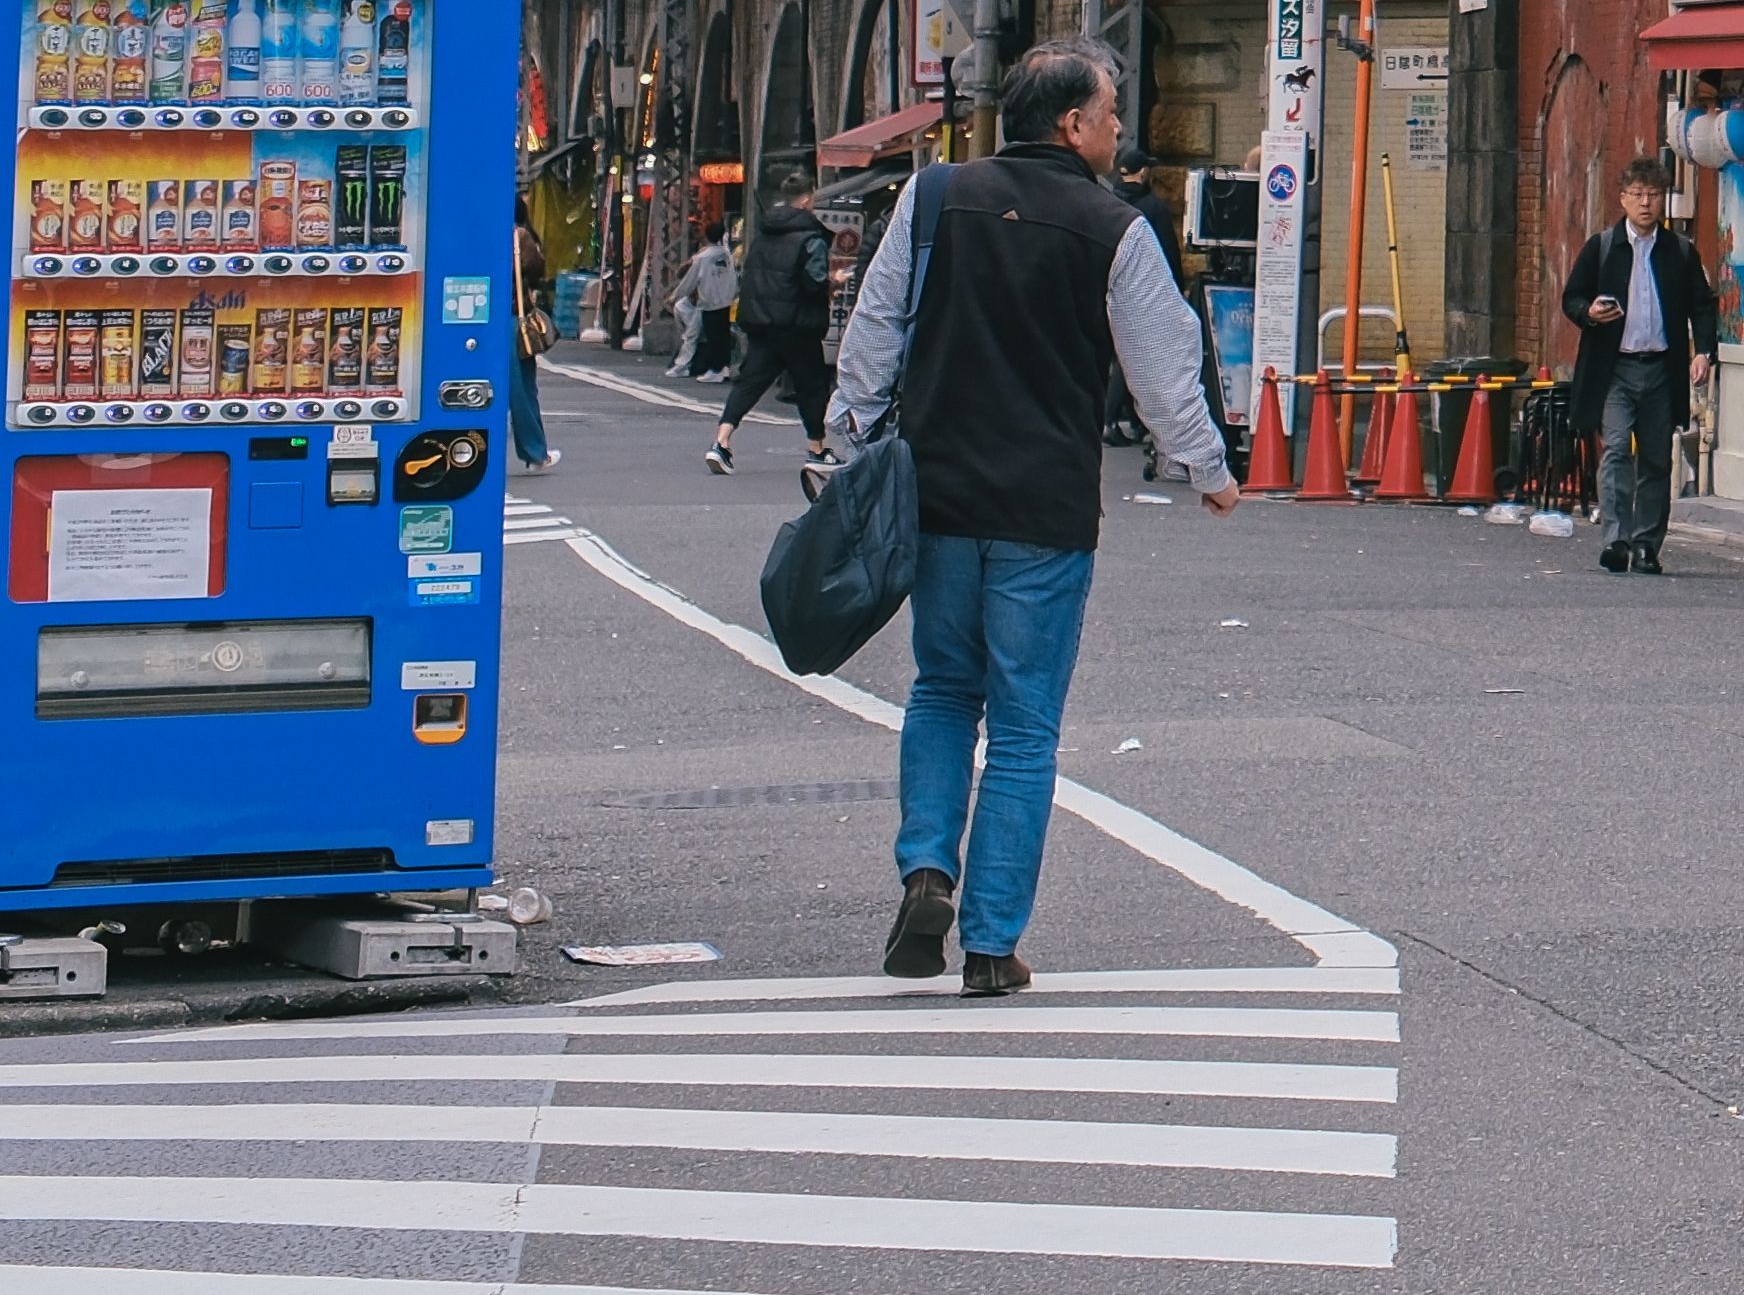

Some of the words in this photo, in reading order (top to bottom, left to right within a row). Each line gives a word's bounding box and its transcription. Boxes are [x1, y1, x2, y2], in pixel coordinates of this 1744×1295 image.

[266, 84, 294, 97] 600
[304, 84, 332, 97] 600
[188, 290, 246, 310] Asahi
[142, 330, 173, 377] BLACK
